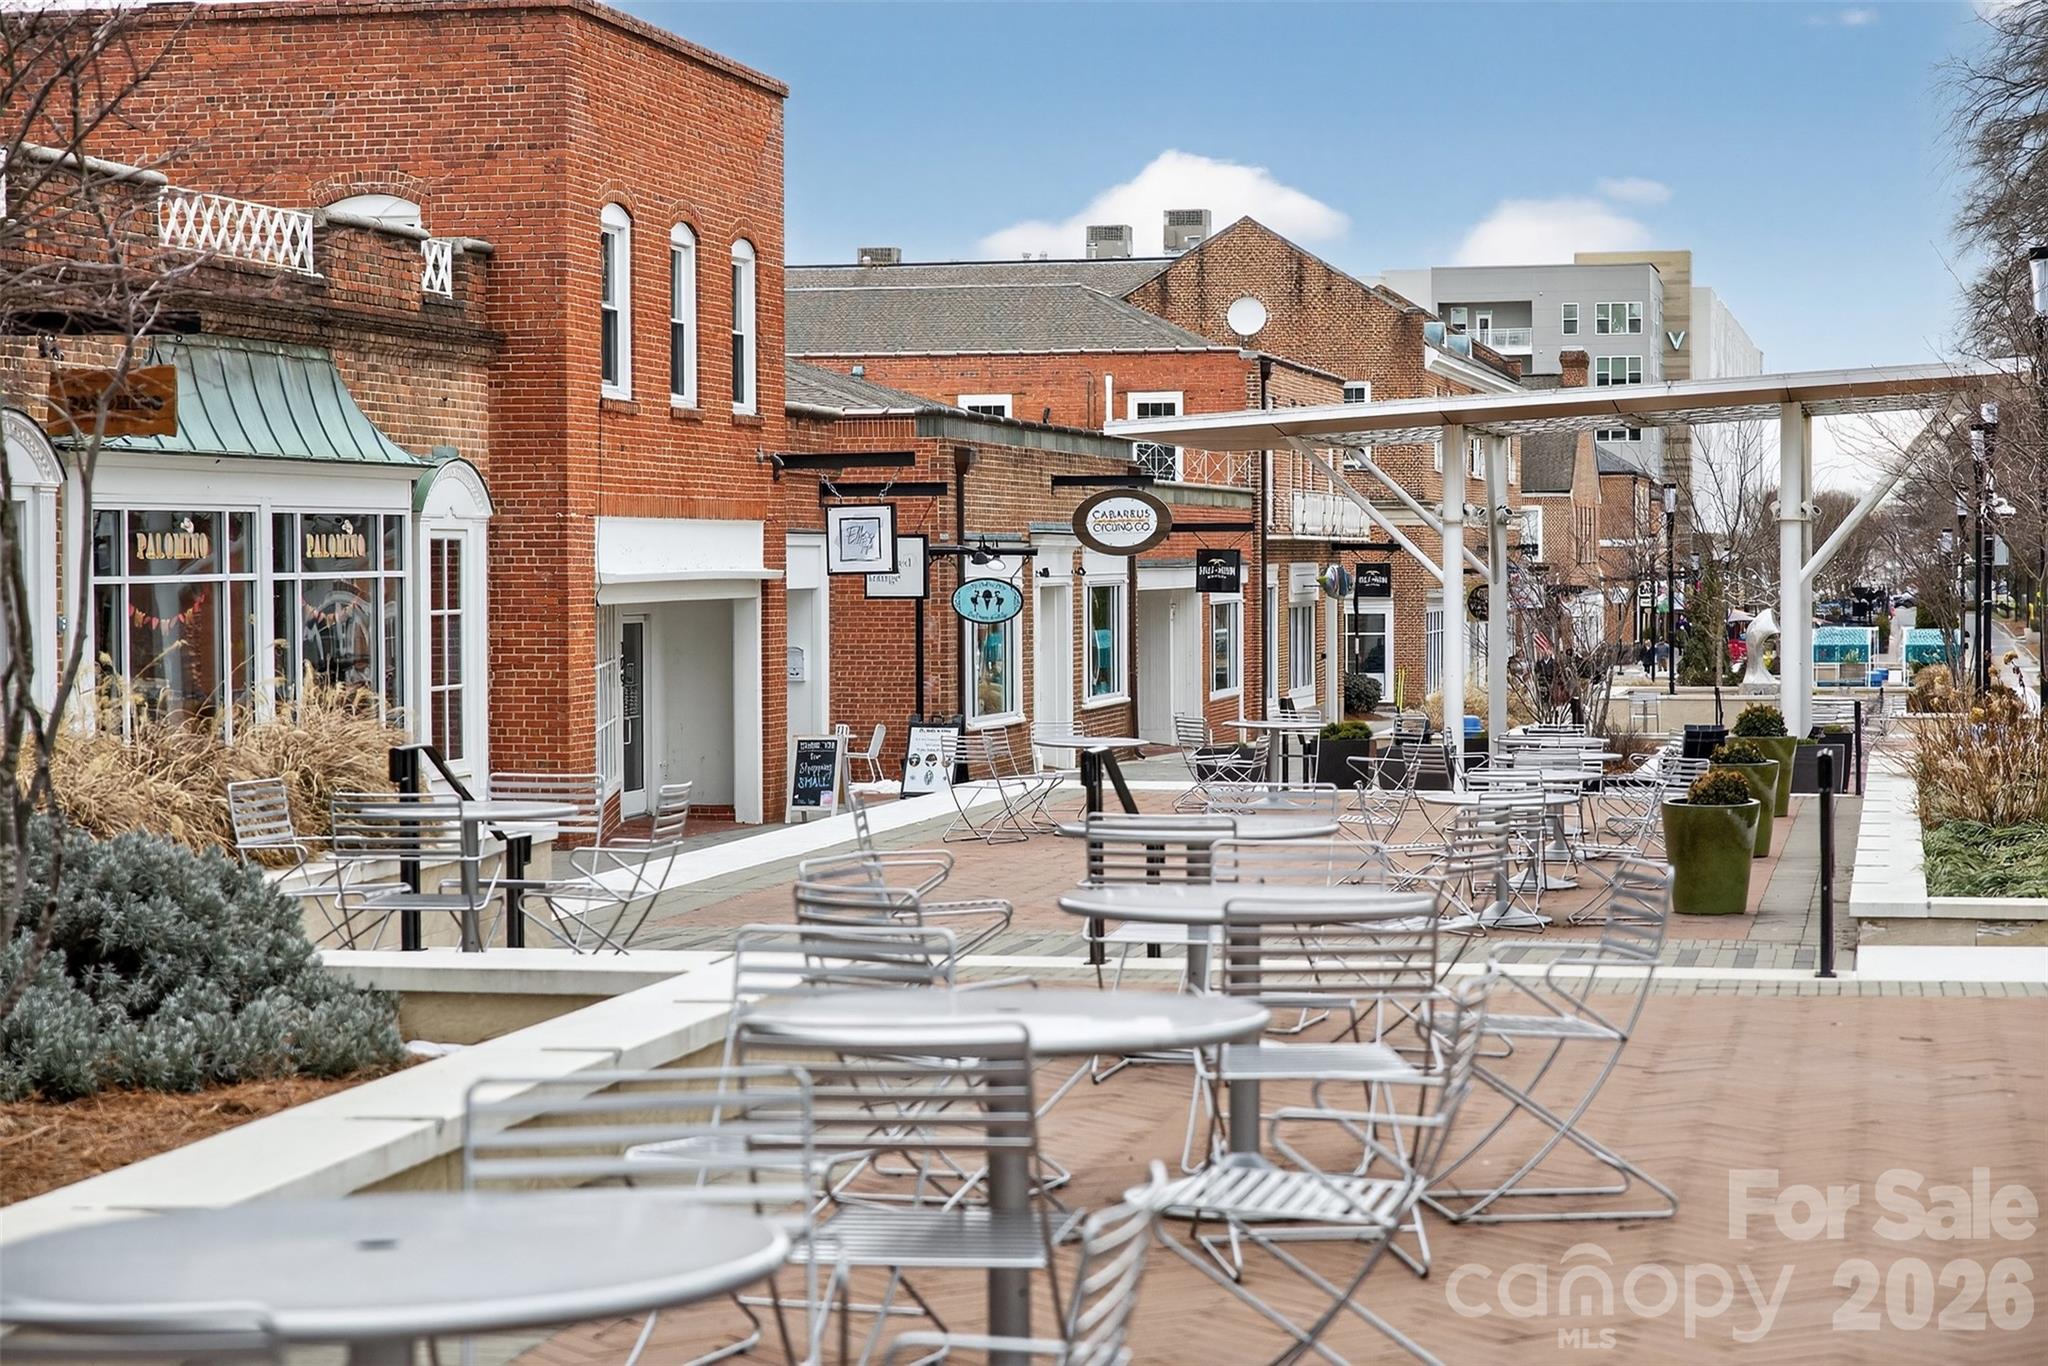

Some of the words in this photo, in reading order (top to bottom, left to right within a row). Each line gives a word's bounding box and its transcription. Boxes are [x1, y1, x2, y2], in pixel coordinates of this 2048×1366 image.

[1092, 508, 1151, 520] CABARRUS
[1092, 521, 1133, 533] CYCLING
[136, 532, 209, 559] PALOMINO
[306, 532, 367, 559] PALOMINO
[799, 762, 832, 780] Shopping
[798, 776, 829, 789] SMALL
